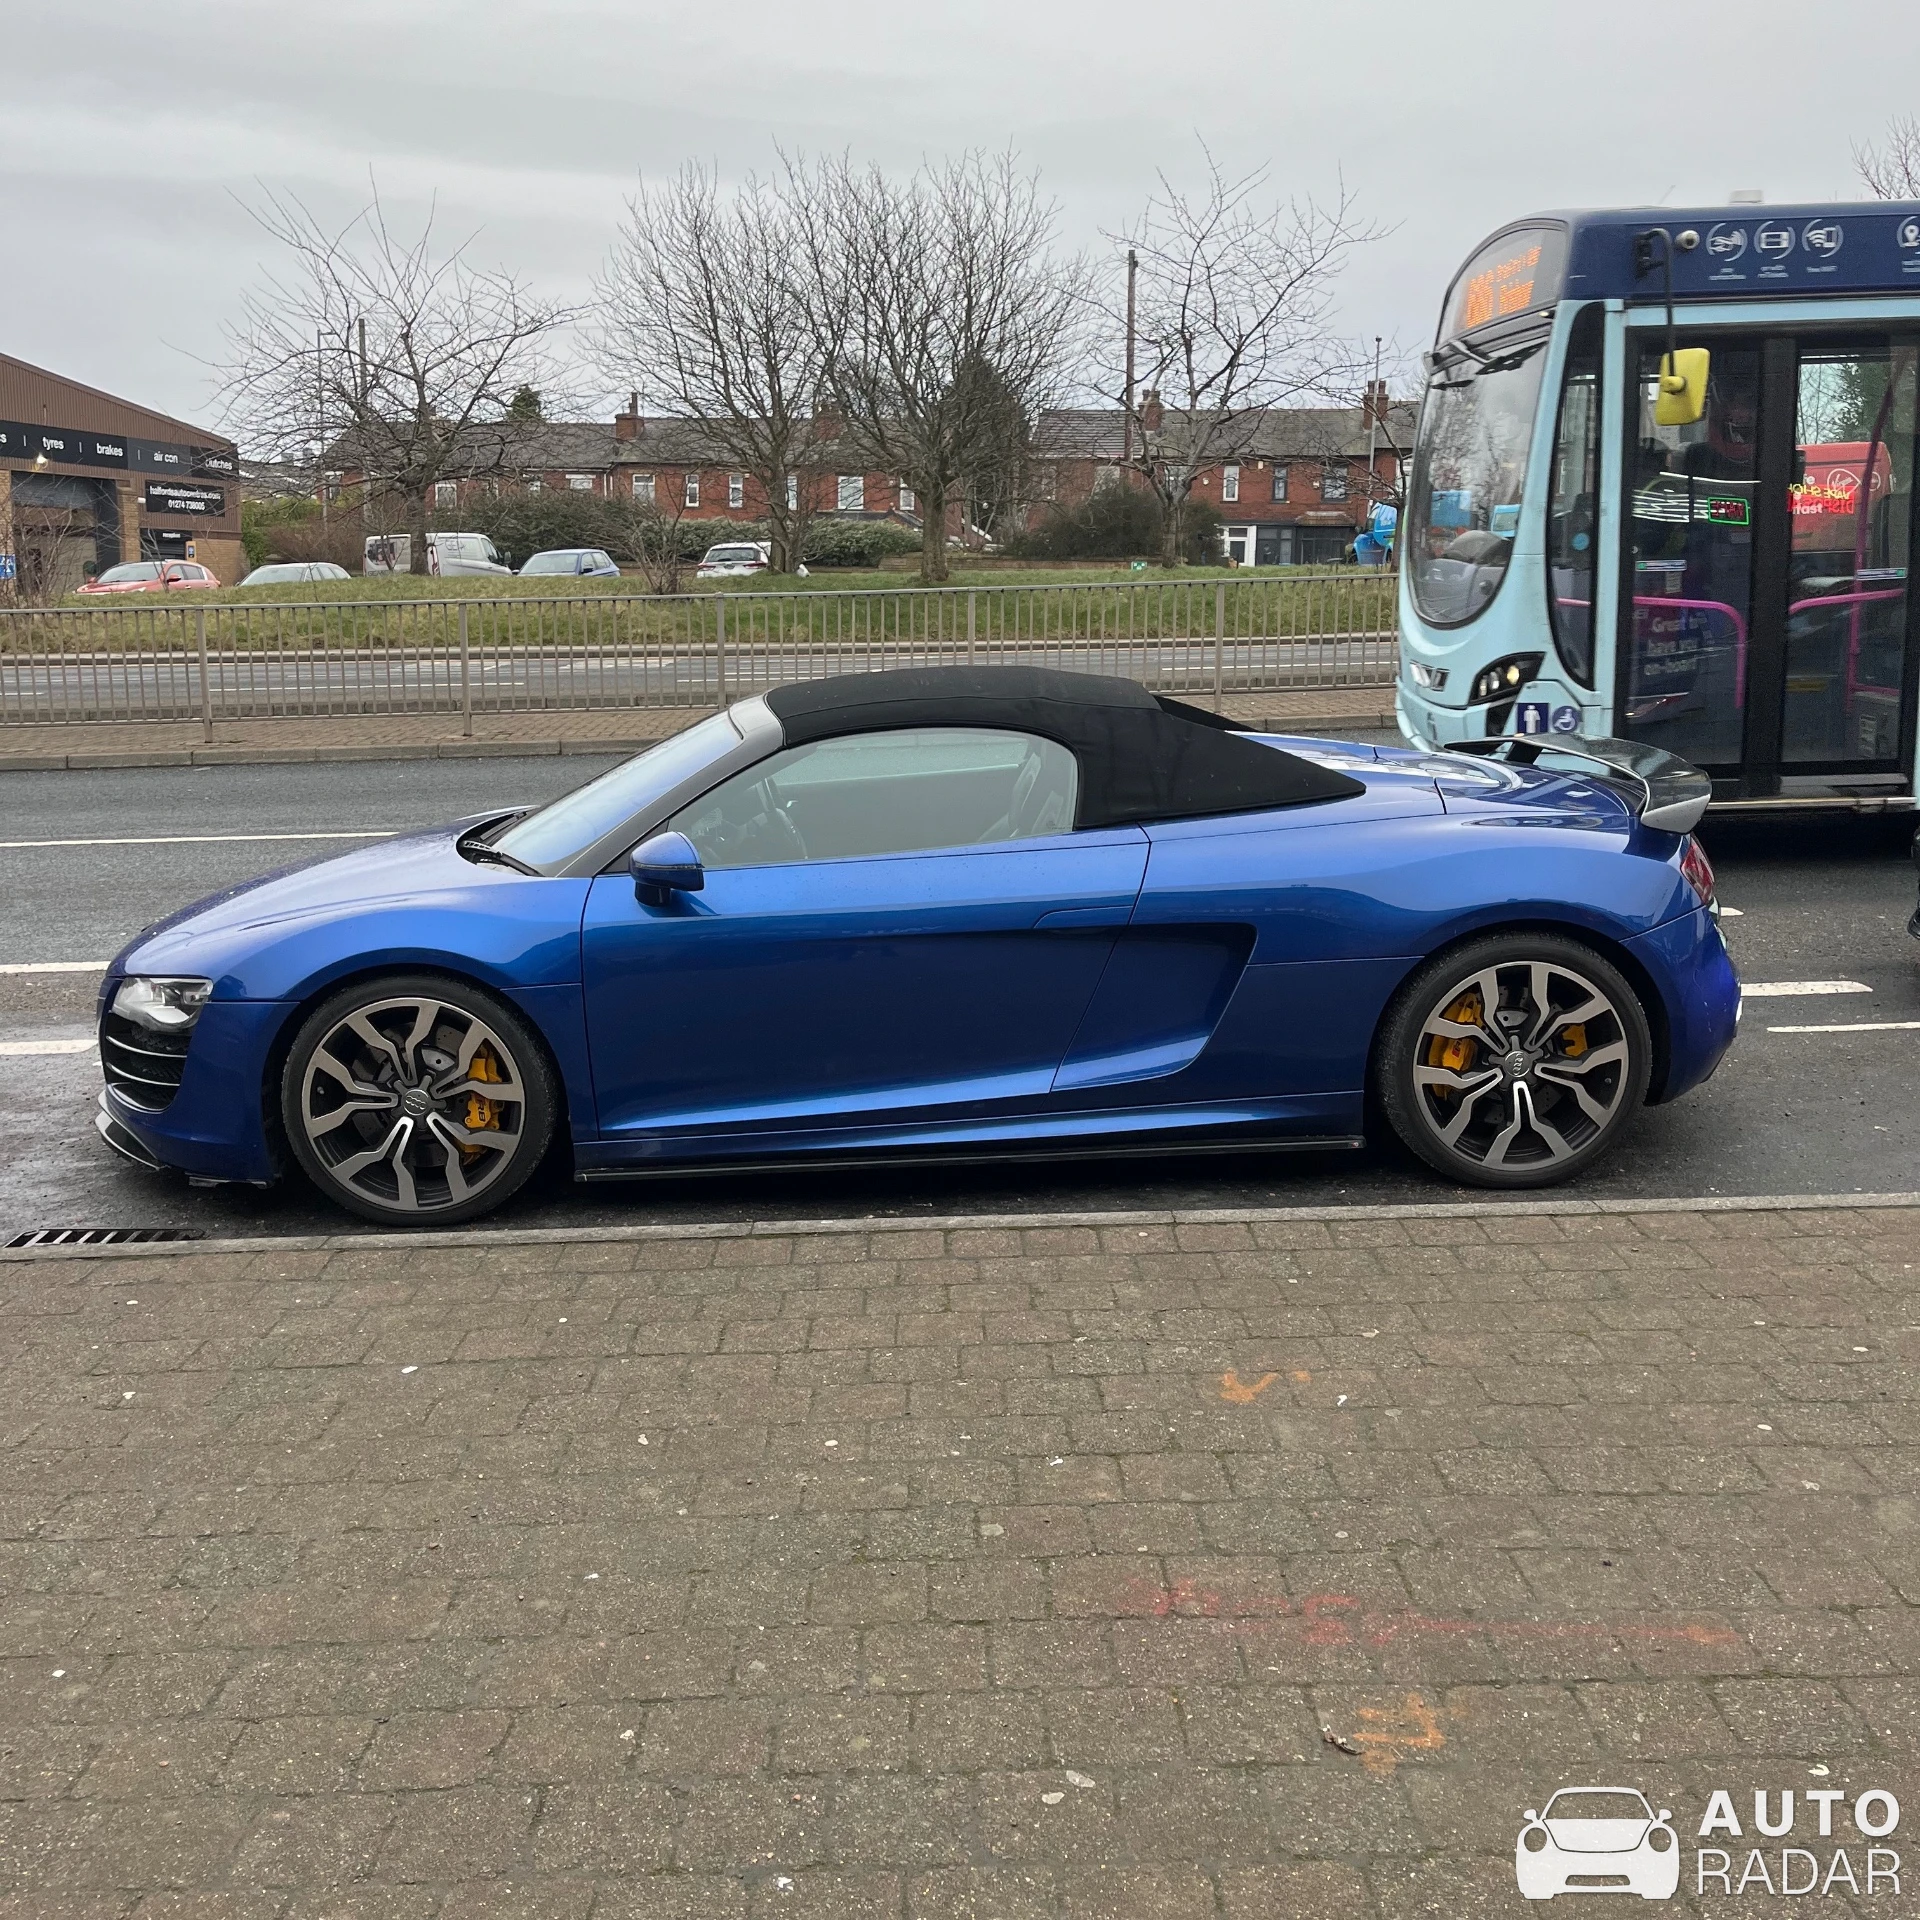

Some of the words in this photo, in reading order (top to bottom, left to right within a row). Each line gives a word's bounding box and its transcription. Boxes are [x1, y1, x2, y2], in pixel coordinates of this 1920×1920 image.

[42, 437, 64, 450] tyres
[96, 443, 123, 457] brakes
[153, 451, 163, 462] air
[165, 454, 179, 464] con
[168, 499, 185, 509] 01274
